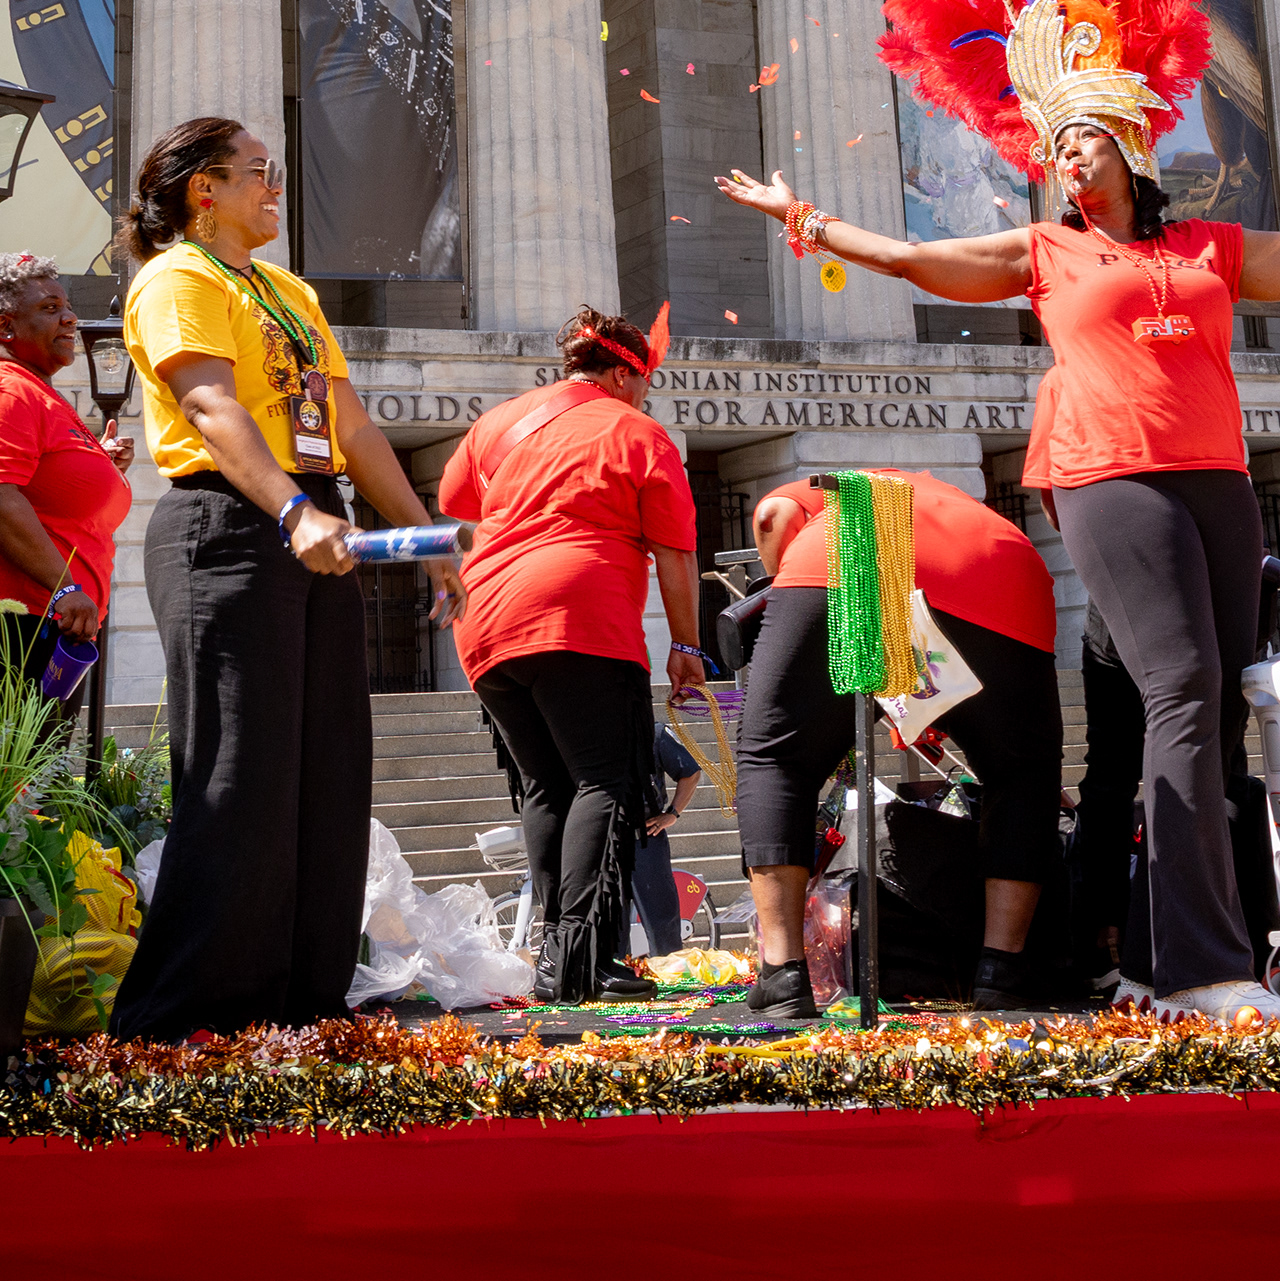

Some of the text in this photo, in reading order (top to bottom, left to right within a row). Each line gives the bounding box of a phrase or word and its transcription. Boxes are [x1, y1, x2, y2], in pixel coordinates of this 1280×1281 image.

[754, 371, 932, 395] INSTITUTION
[673, 399, 748, 426] FOR
[760, 401, 948, 429] AMERICAN
[963, 404, 1026, 429] ART
